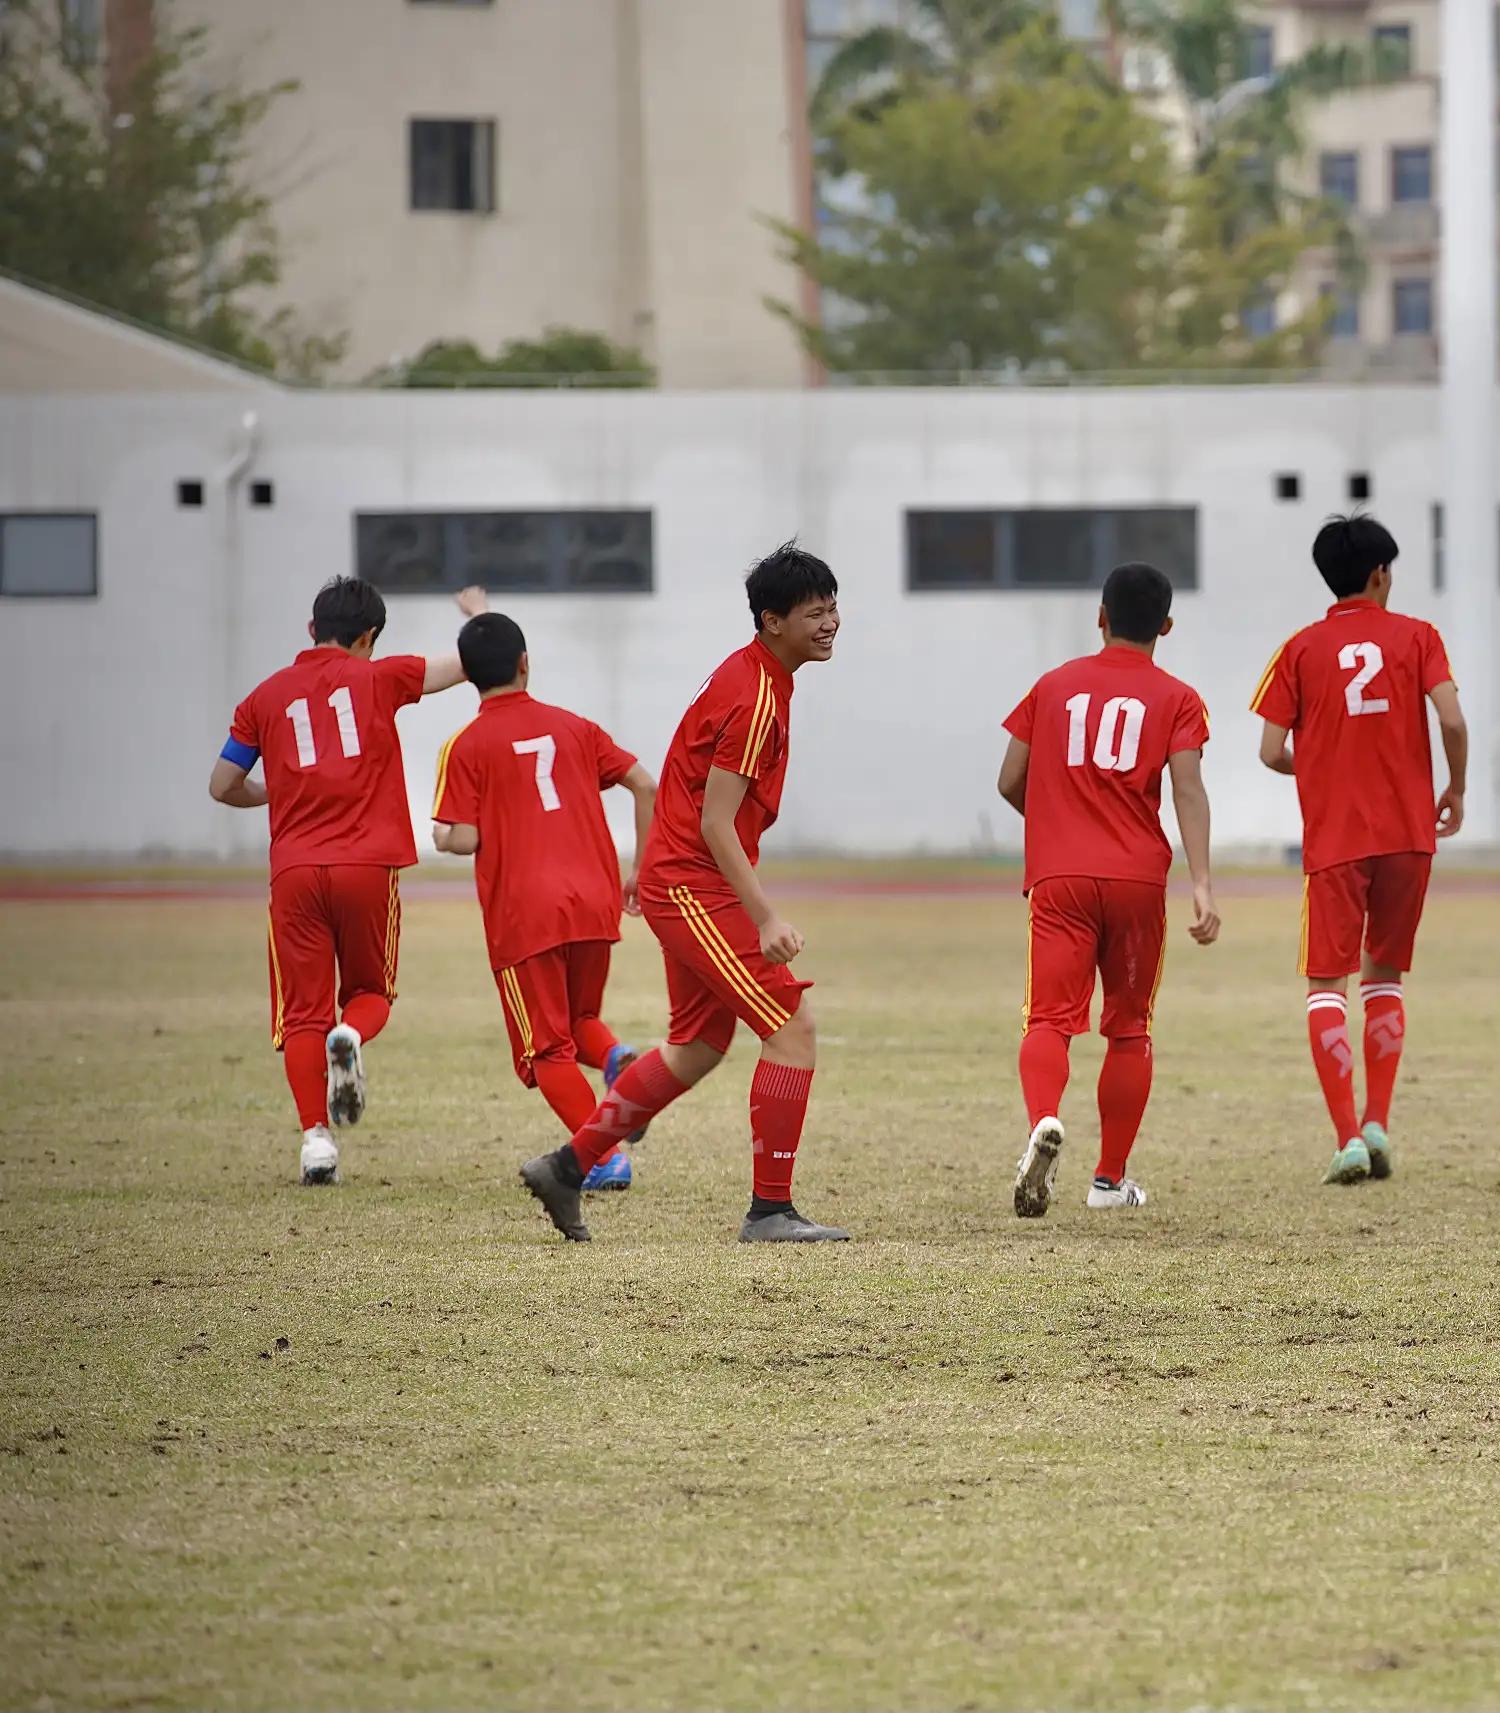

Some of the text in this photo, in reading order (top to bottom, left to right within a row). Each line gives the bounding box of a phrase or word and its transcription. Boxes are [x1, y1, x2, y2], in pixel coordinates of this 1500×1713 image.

[1337, 641, 1389, 716] 2
[285, 686, 361, 768] 11
[1065, 693, 1146, 772] 10
[511, 734, 562, 812] 7
